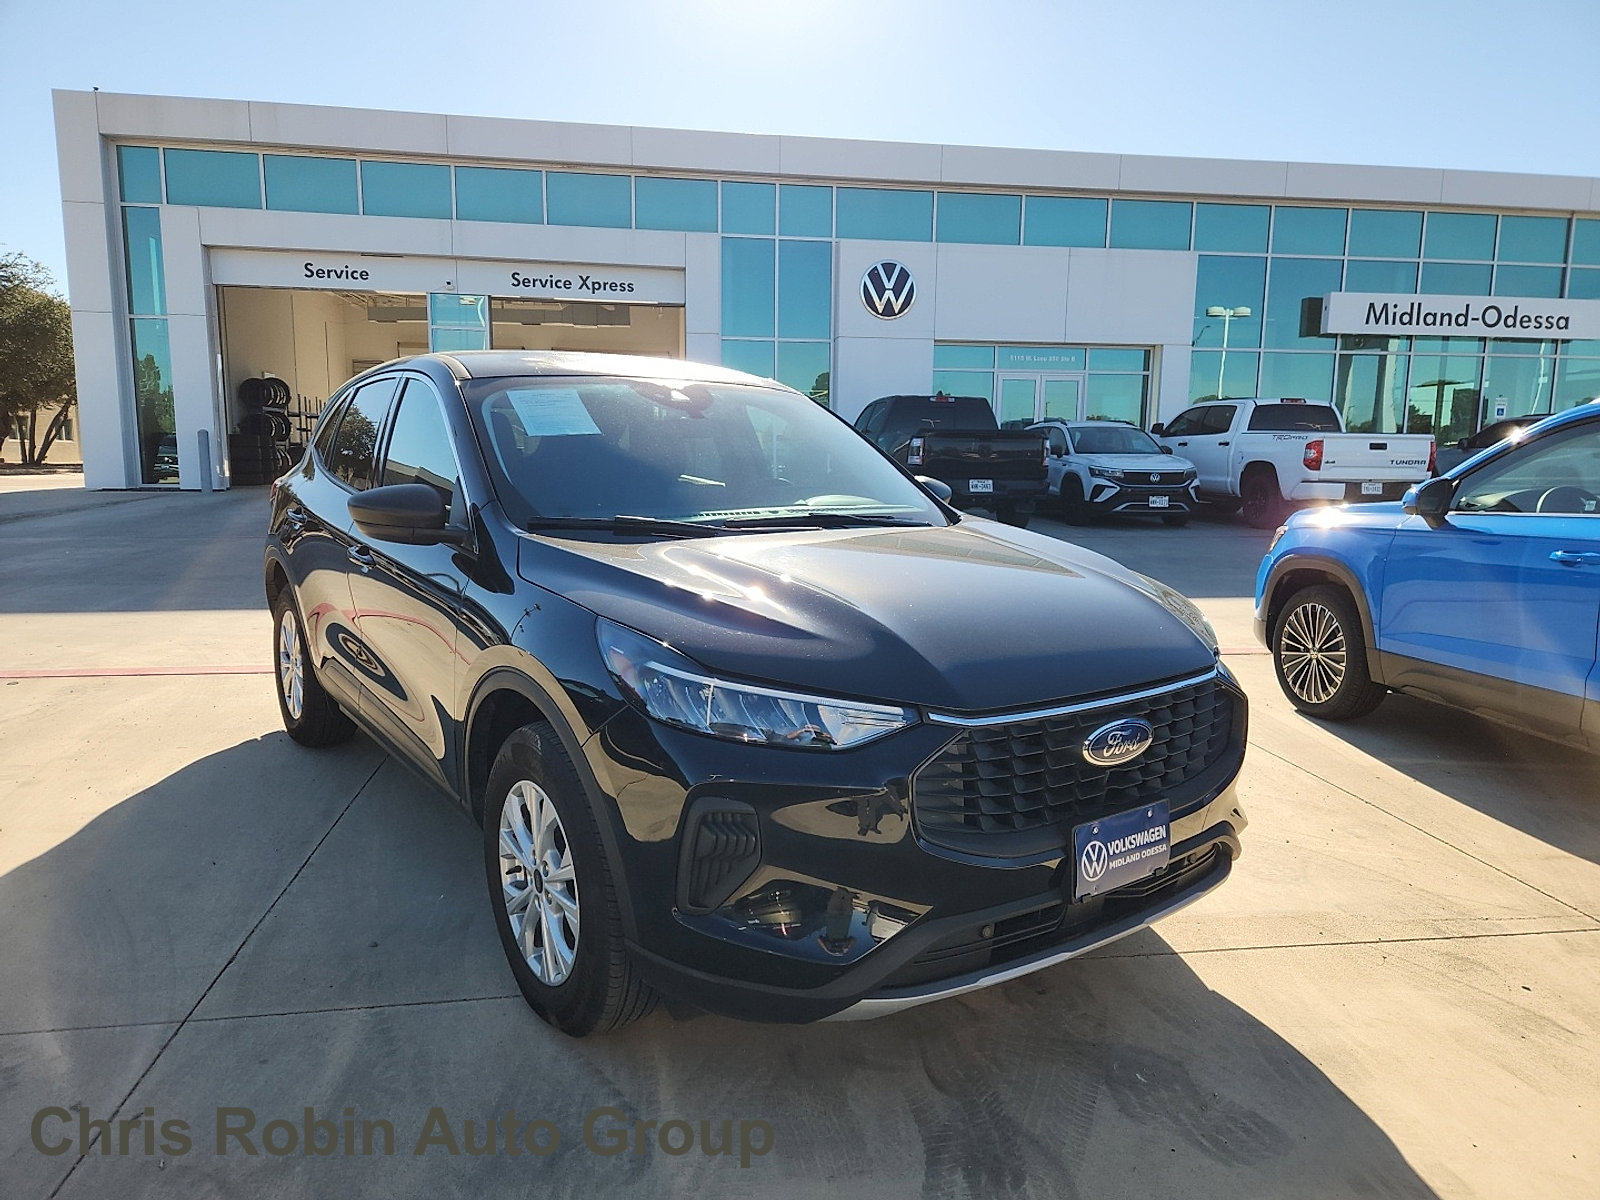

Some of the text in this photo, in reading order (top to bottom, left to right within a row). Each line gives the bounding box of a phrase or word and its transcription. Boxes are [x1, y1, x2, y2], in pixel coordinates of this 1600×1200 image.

[304, 263, 369, 281] Service
[511, 272, 635, 294] Service Xpress
[861, 260, 916, 319] VW
[1365, 302, 1570, 331] Midland-Odessa
[1103, 729, 1141, 758] Ford
[1107, 825, 1166, 856] VOLKSWAGEN
[1109, 844, 1167, 869] MIDLAND ODESSA
